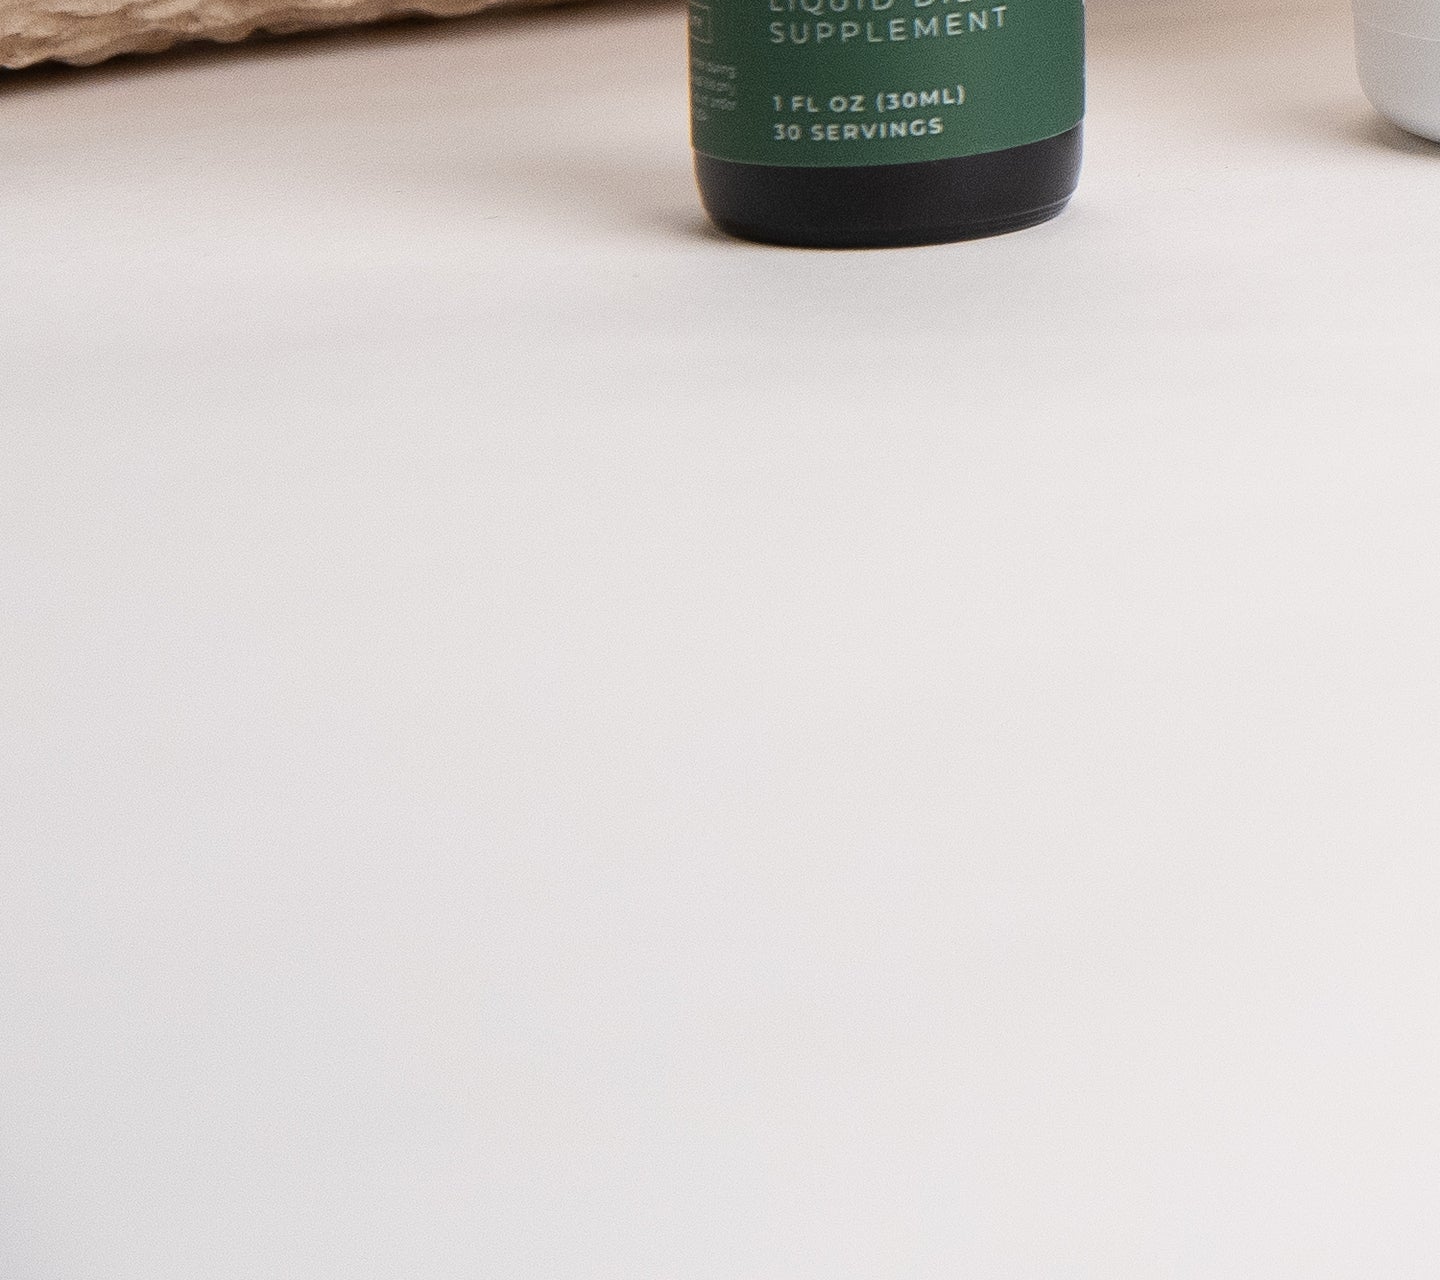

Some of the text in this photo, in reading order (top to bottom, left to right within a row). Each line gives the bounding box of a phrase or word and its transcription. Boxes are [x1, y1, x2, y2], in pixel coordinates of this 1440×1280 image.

[768, 5, 1009, 44] SUPPLEMENT
[772, 85, 967, 113] 1 FL OZ (30ML)
[773, 117, 945, 141] 30 SERVINGS
